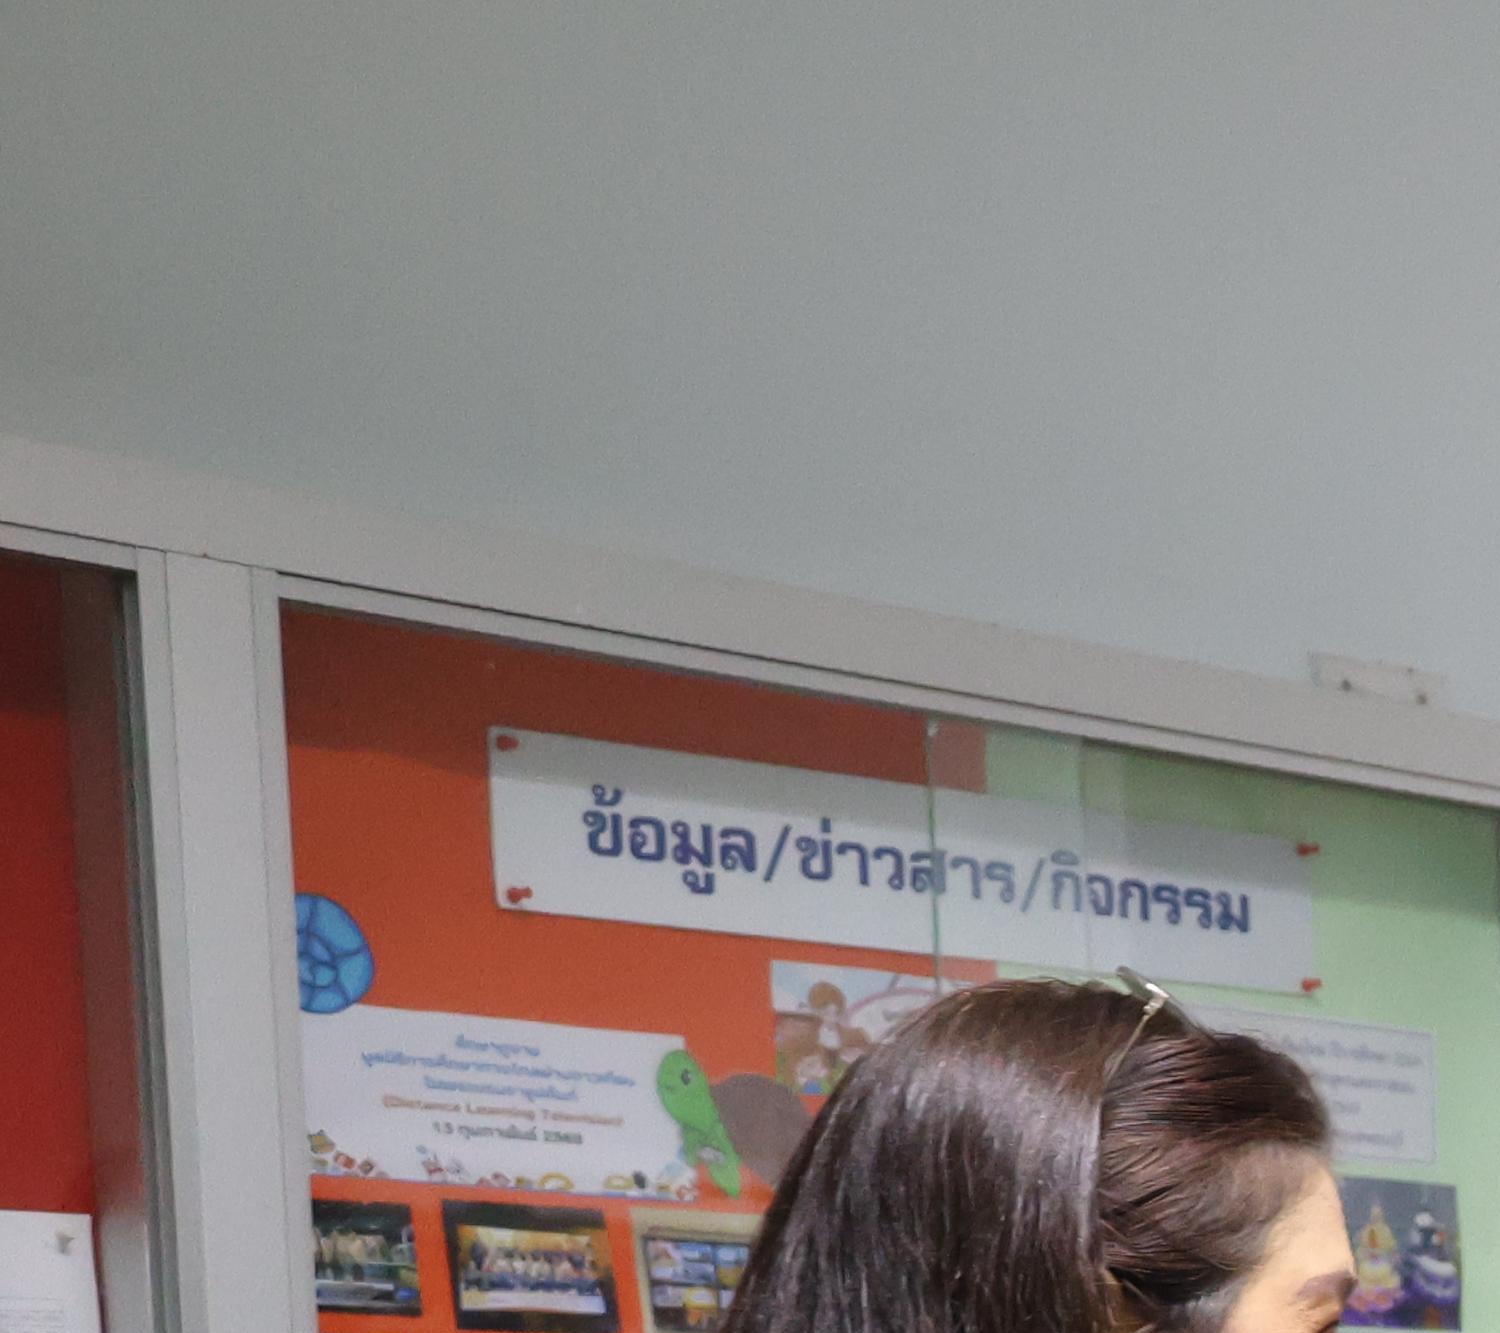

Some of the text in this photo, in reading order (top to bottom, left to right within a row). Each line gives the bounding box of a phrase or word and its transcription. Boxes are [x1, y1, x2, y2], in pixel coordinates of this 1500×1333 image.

[582, 783, 1250, 933] ข้อมูล/ข่าวสาร/กิจกรรม
